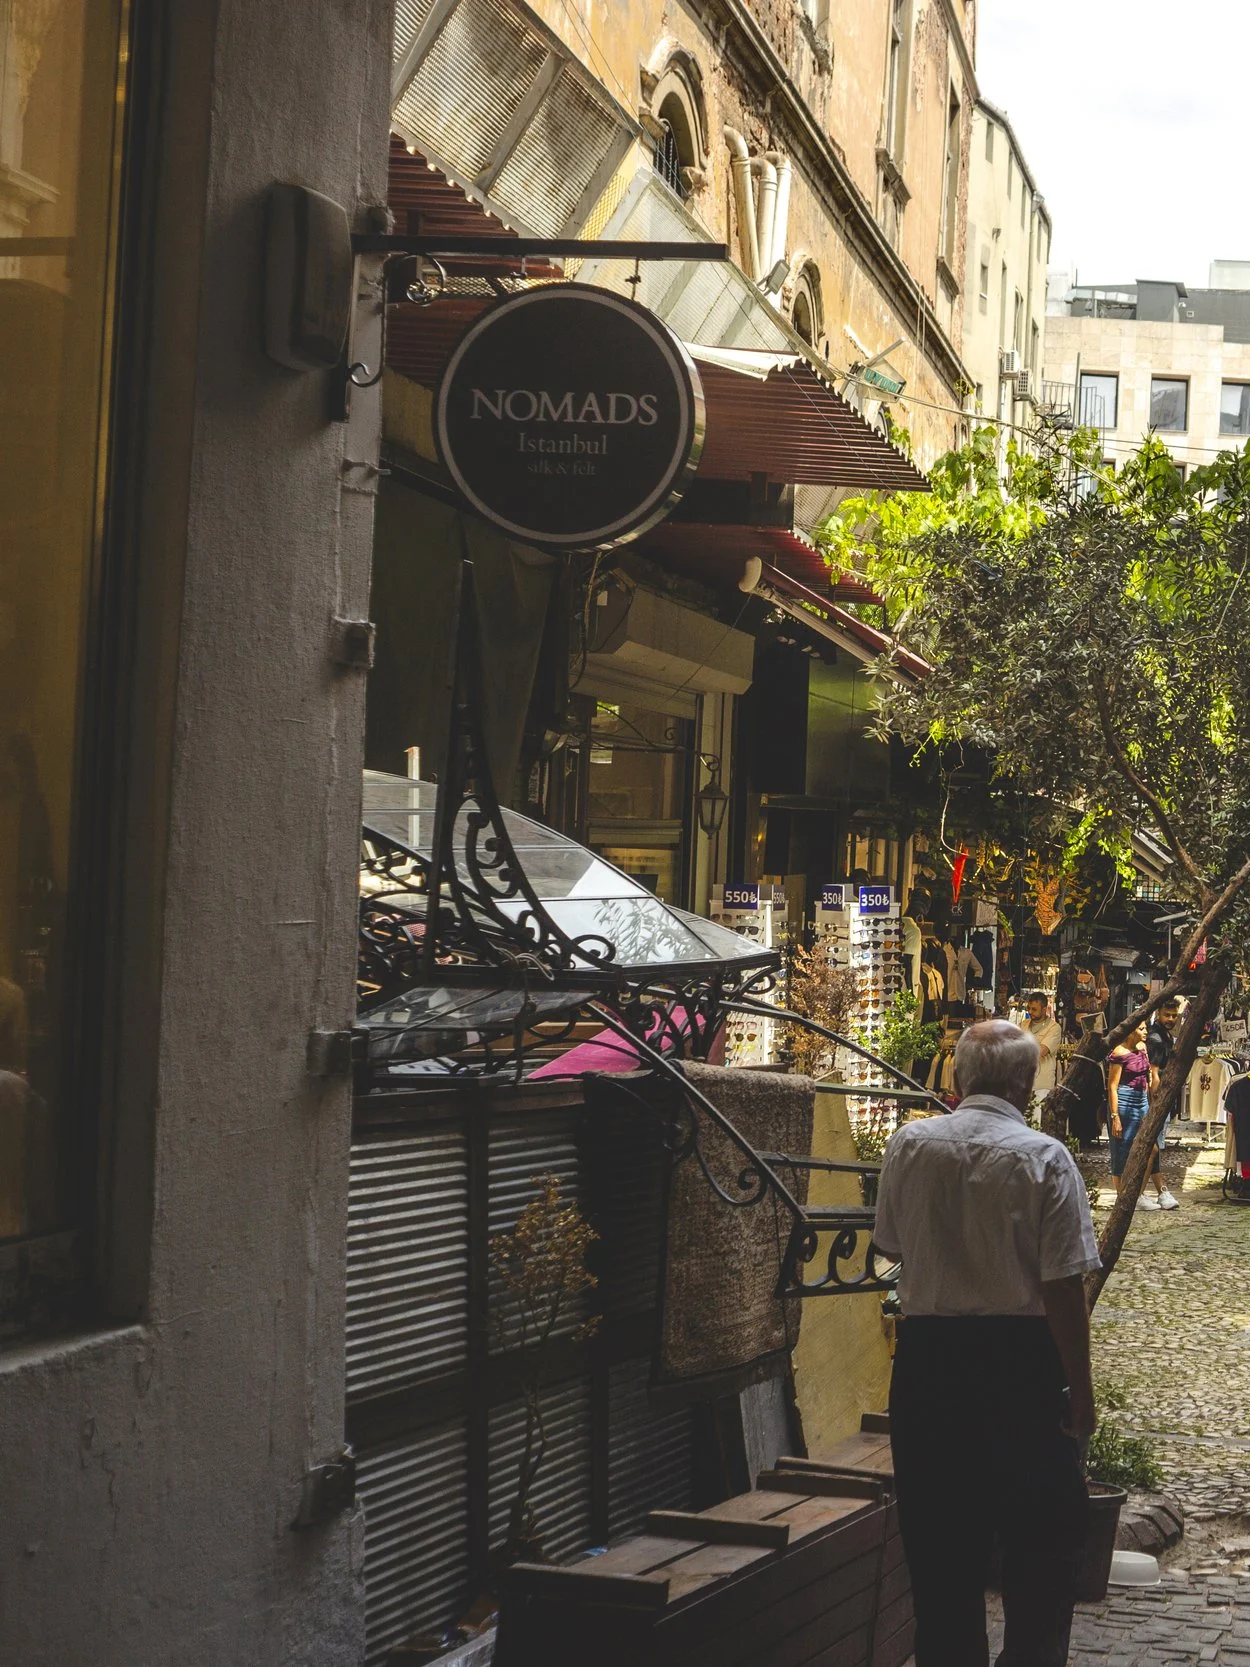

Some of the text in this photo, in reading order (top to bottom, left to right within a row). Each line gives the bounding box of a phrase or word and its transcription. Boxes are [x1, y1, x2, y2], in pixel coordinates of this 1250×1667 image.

[470, 388, 658, 426] NOMADS
[518, 432, 608, 455] Istanbul
[527, 460, 596, 475] silk & felt
